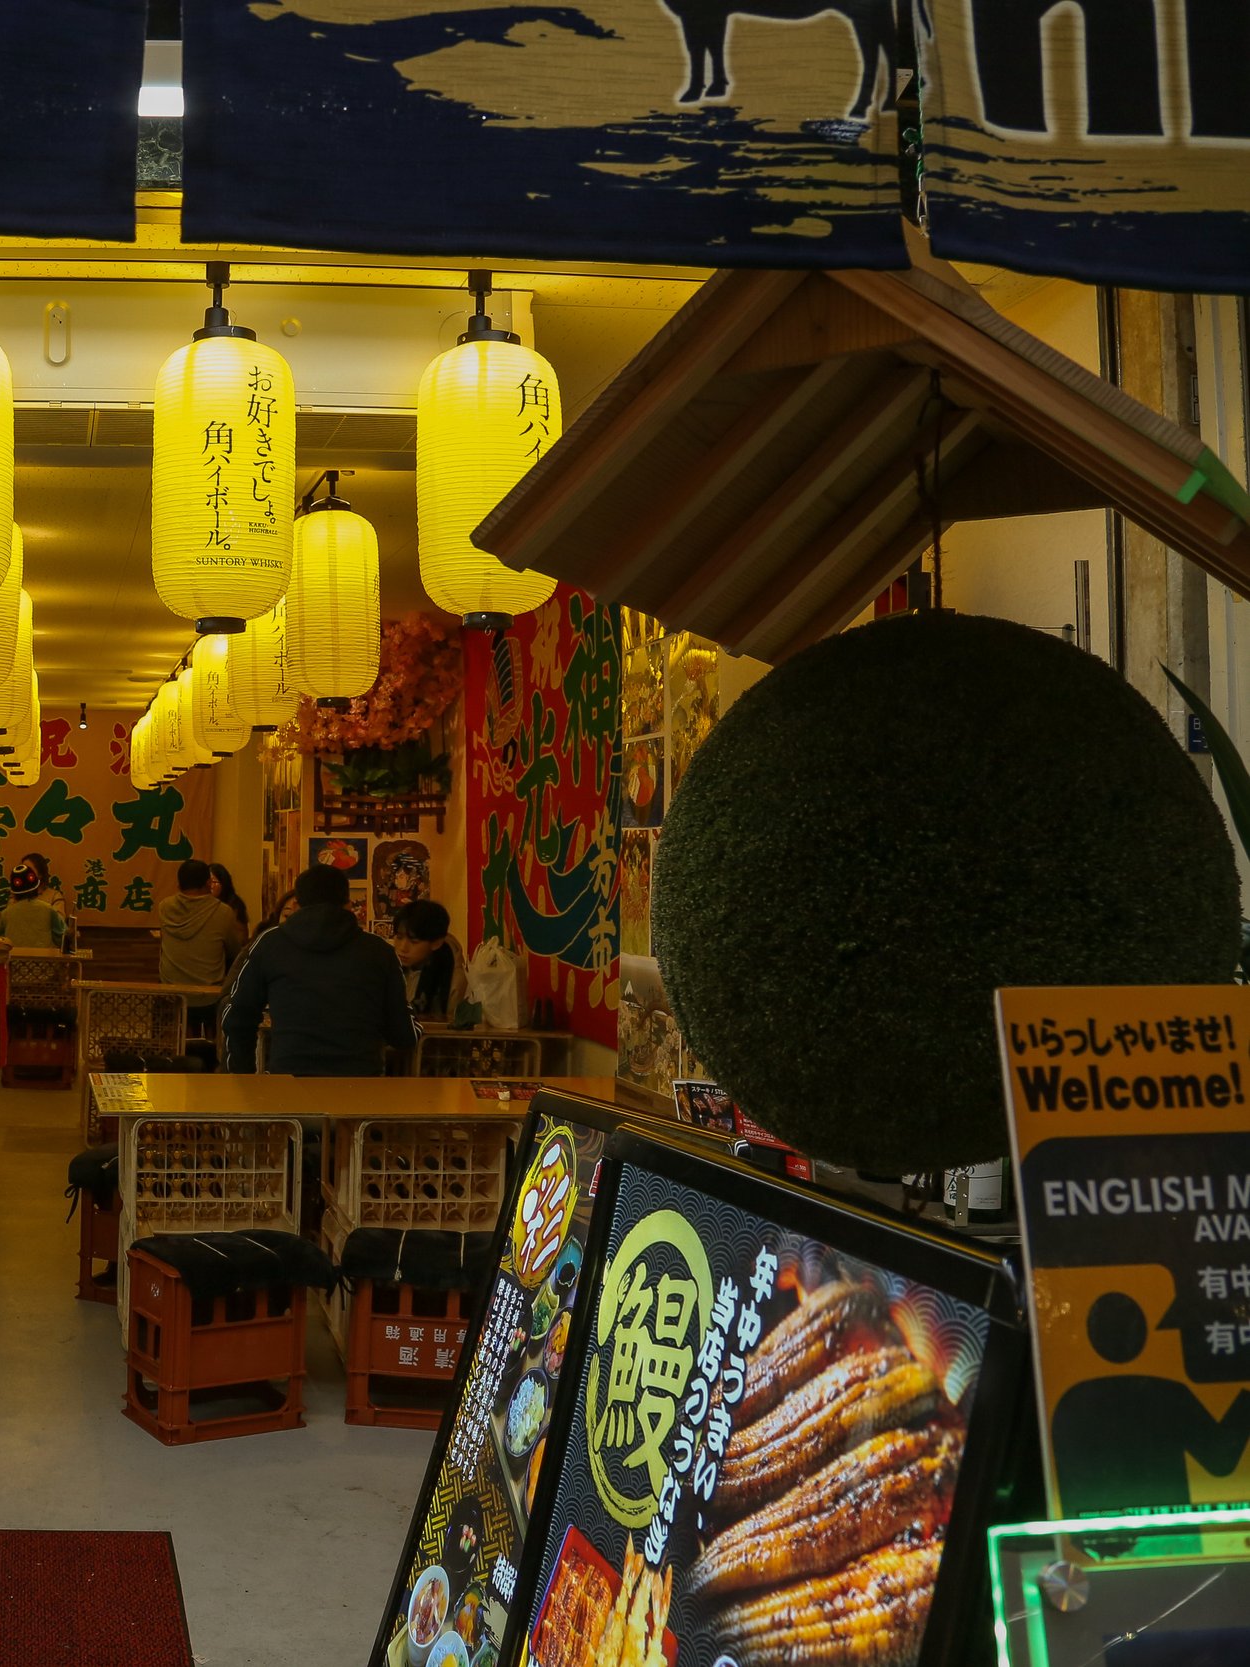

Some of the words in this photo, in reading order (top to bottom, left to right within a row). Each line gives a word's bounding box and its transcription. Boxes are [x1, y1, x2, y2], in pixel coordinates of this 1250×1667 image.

[247, 365, 279, 525] お好きでしょ。
[201, 420, 234, 551] 角ハイボール。
[195, 557, 248, 567] SUNTORY
[249, 557, 285, 569] WHISKY
[1016, 1061, 1246, 1113] Welcome!
[1043, 1175, 1216, 1217] ENGLISH
